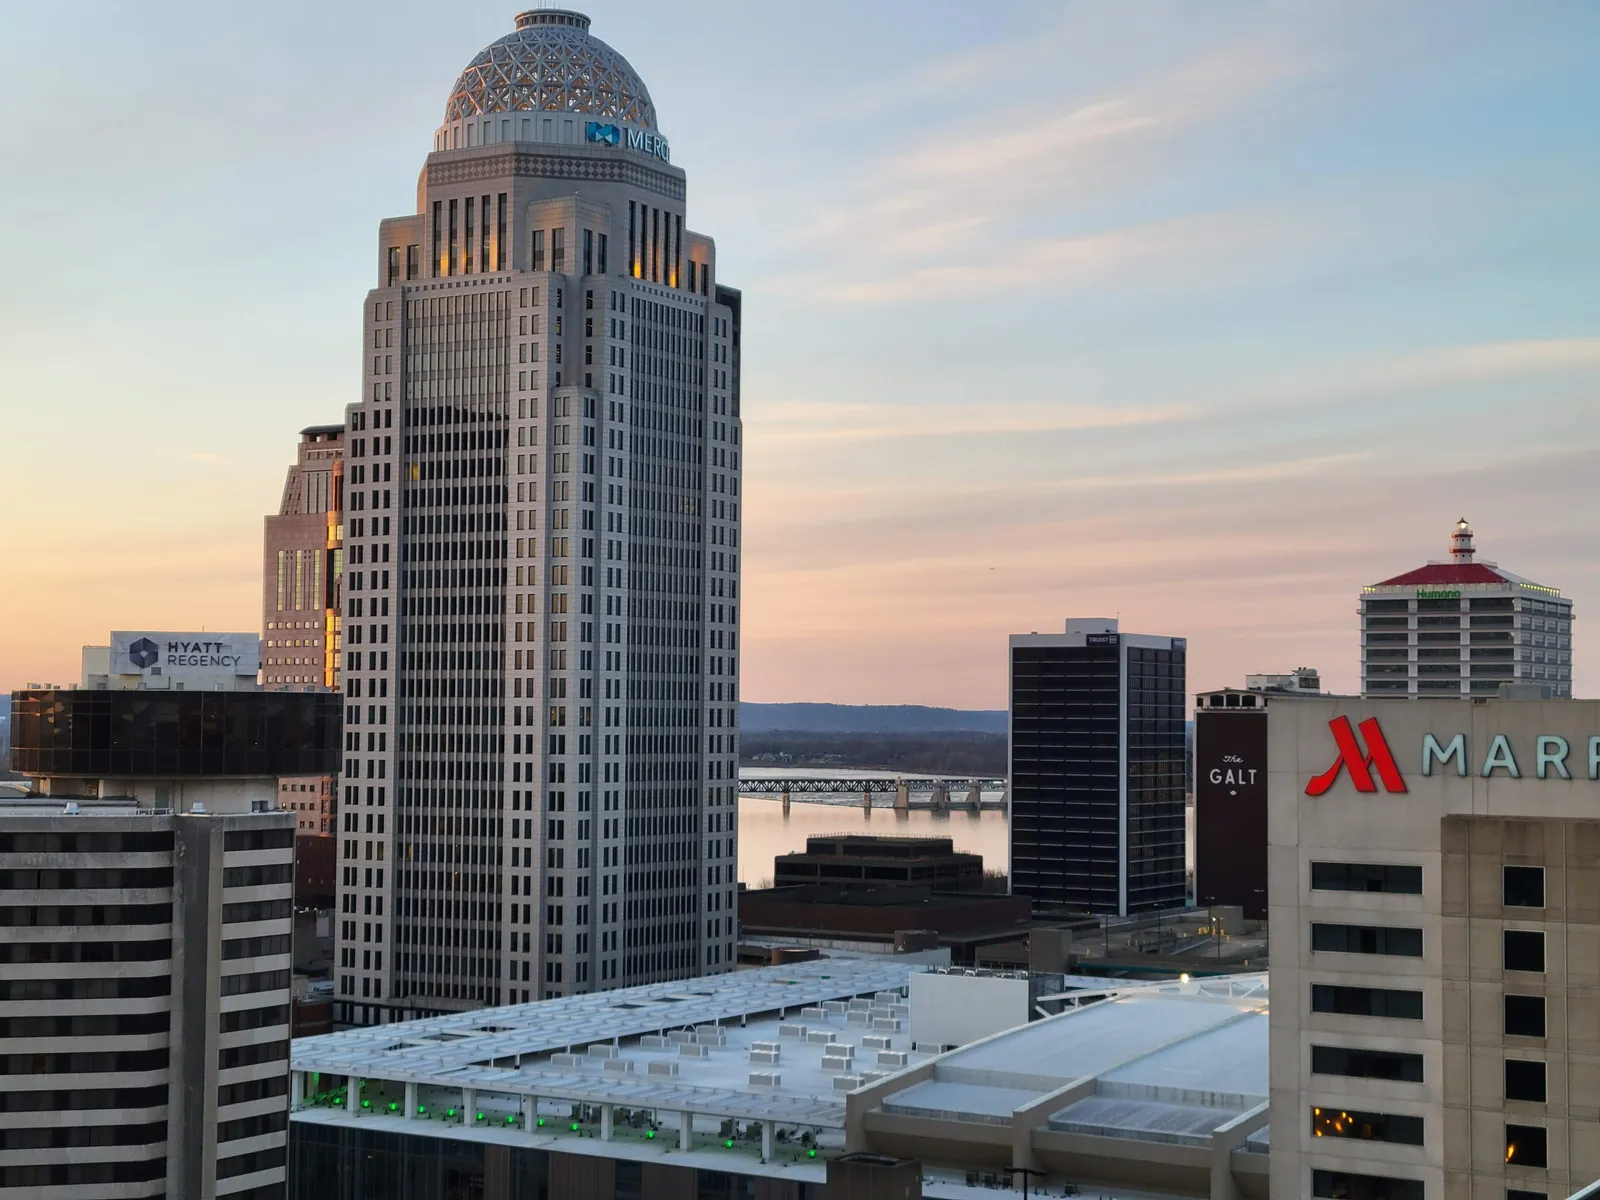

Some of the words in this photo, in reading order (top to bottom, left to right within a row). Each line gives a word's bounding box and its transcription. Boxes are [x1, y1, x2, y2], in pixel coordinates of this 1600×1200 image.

[628, 128, 671, 163] MERC
[1416, 589, 1461, 598] Humana
[168, 642, 223, 653] HYATT
[168, 655, 241, 667] REGENCY
[1223, 755, 1244, 763] The
[1209, 768, 1258, 785] GALT
